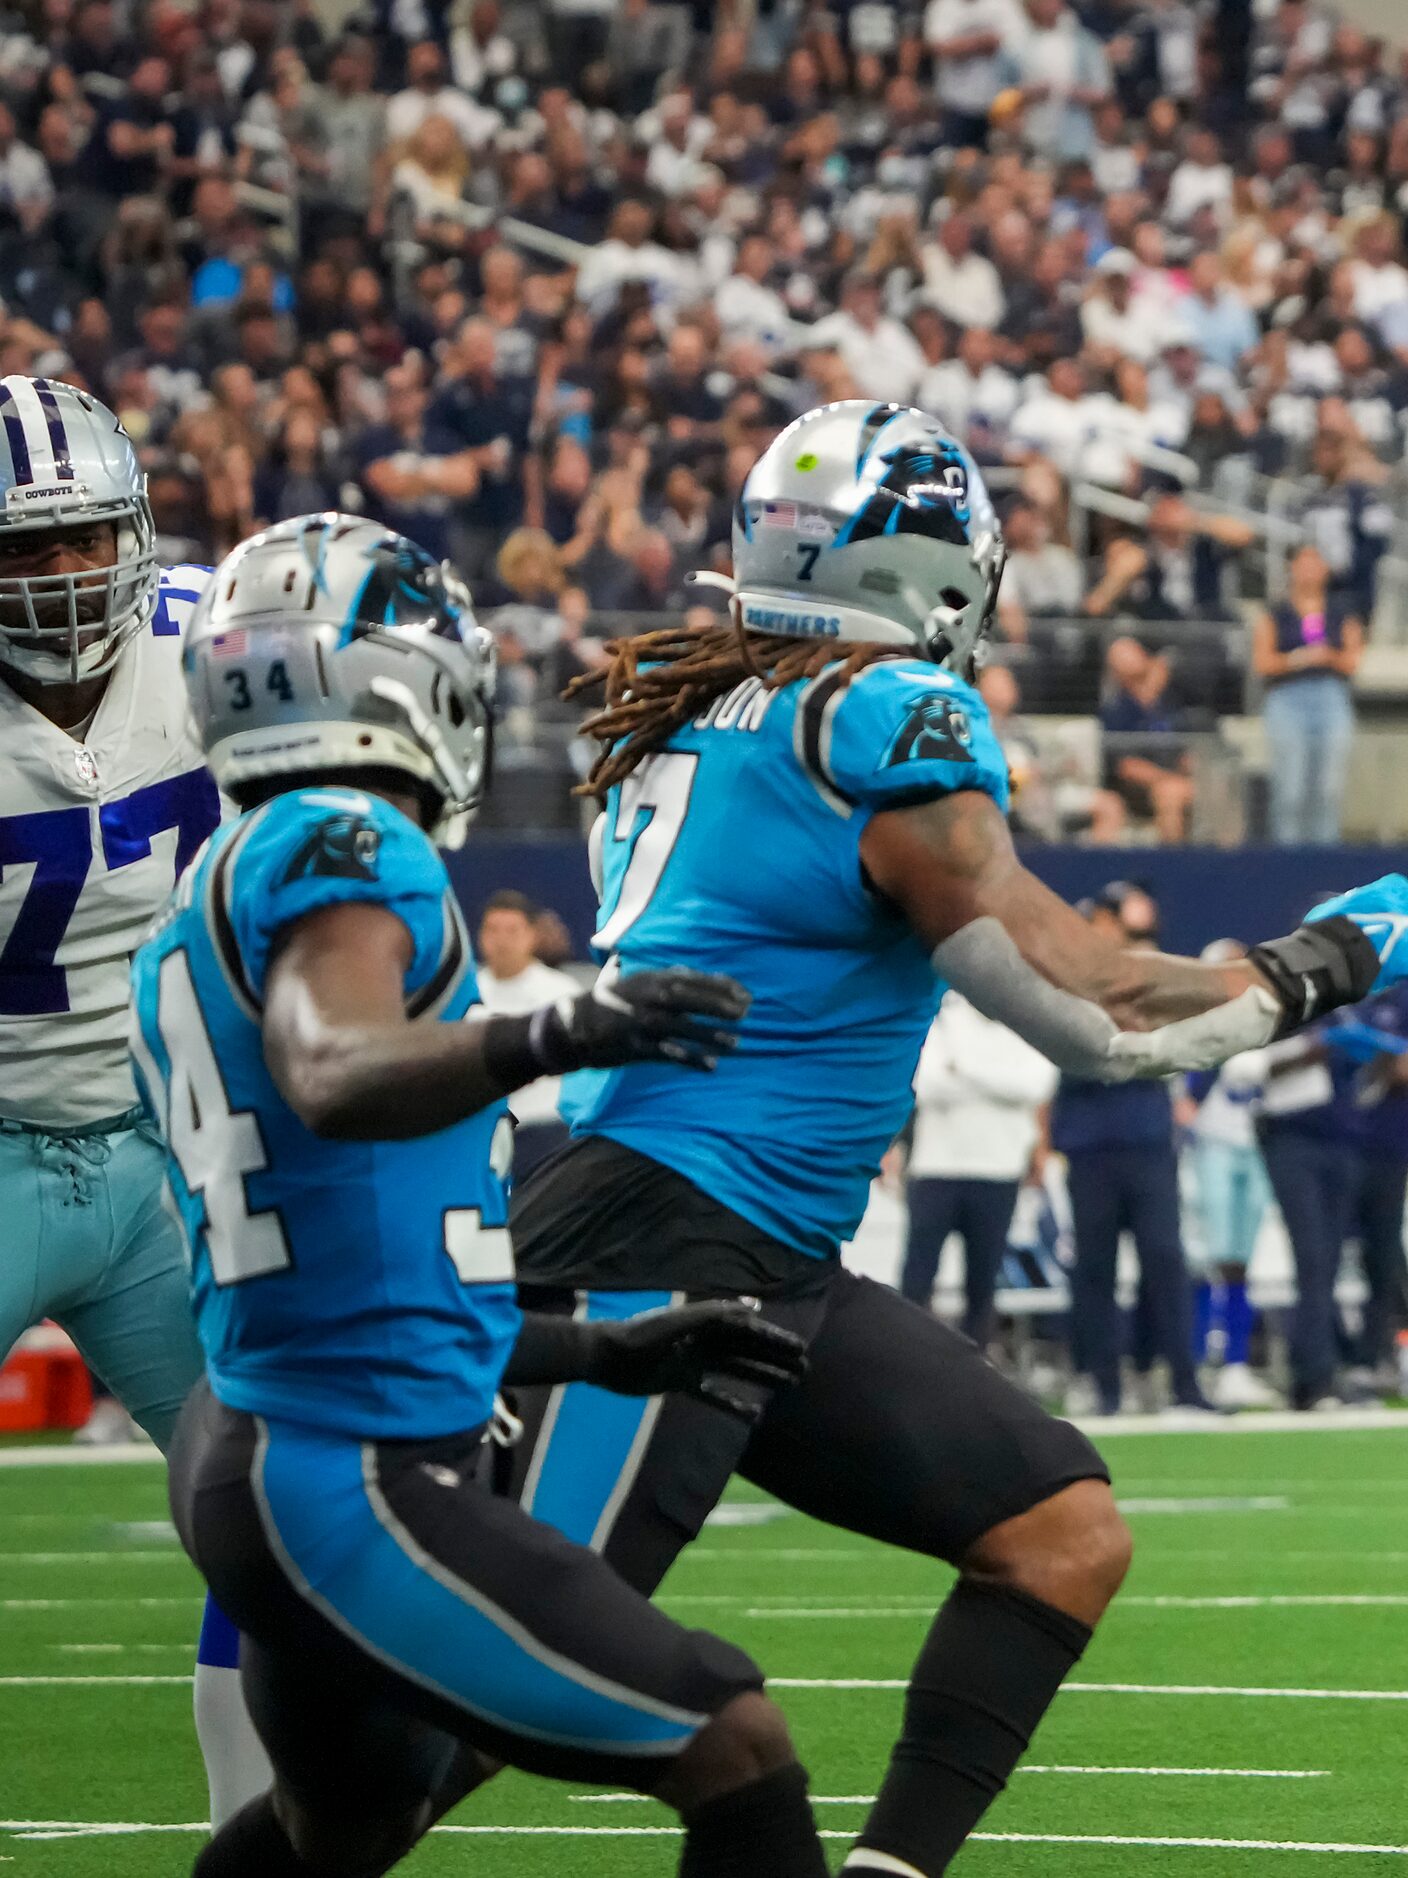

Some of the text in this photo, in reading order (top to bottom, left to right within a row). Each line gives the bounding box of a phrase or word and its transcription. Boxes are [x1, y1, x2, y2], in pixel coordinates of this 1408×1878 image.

[25, 486, 72, 499] COWBOYS
[797, 542, 821, 581] 7
[224, 659, 294, 710] 34
[590, 751, 700, 950] 7
